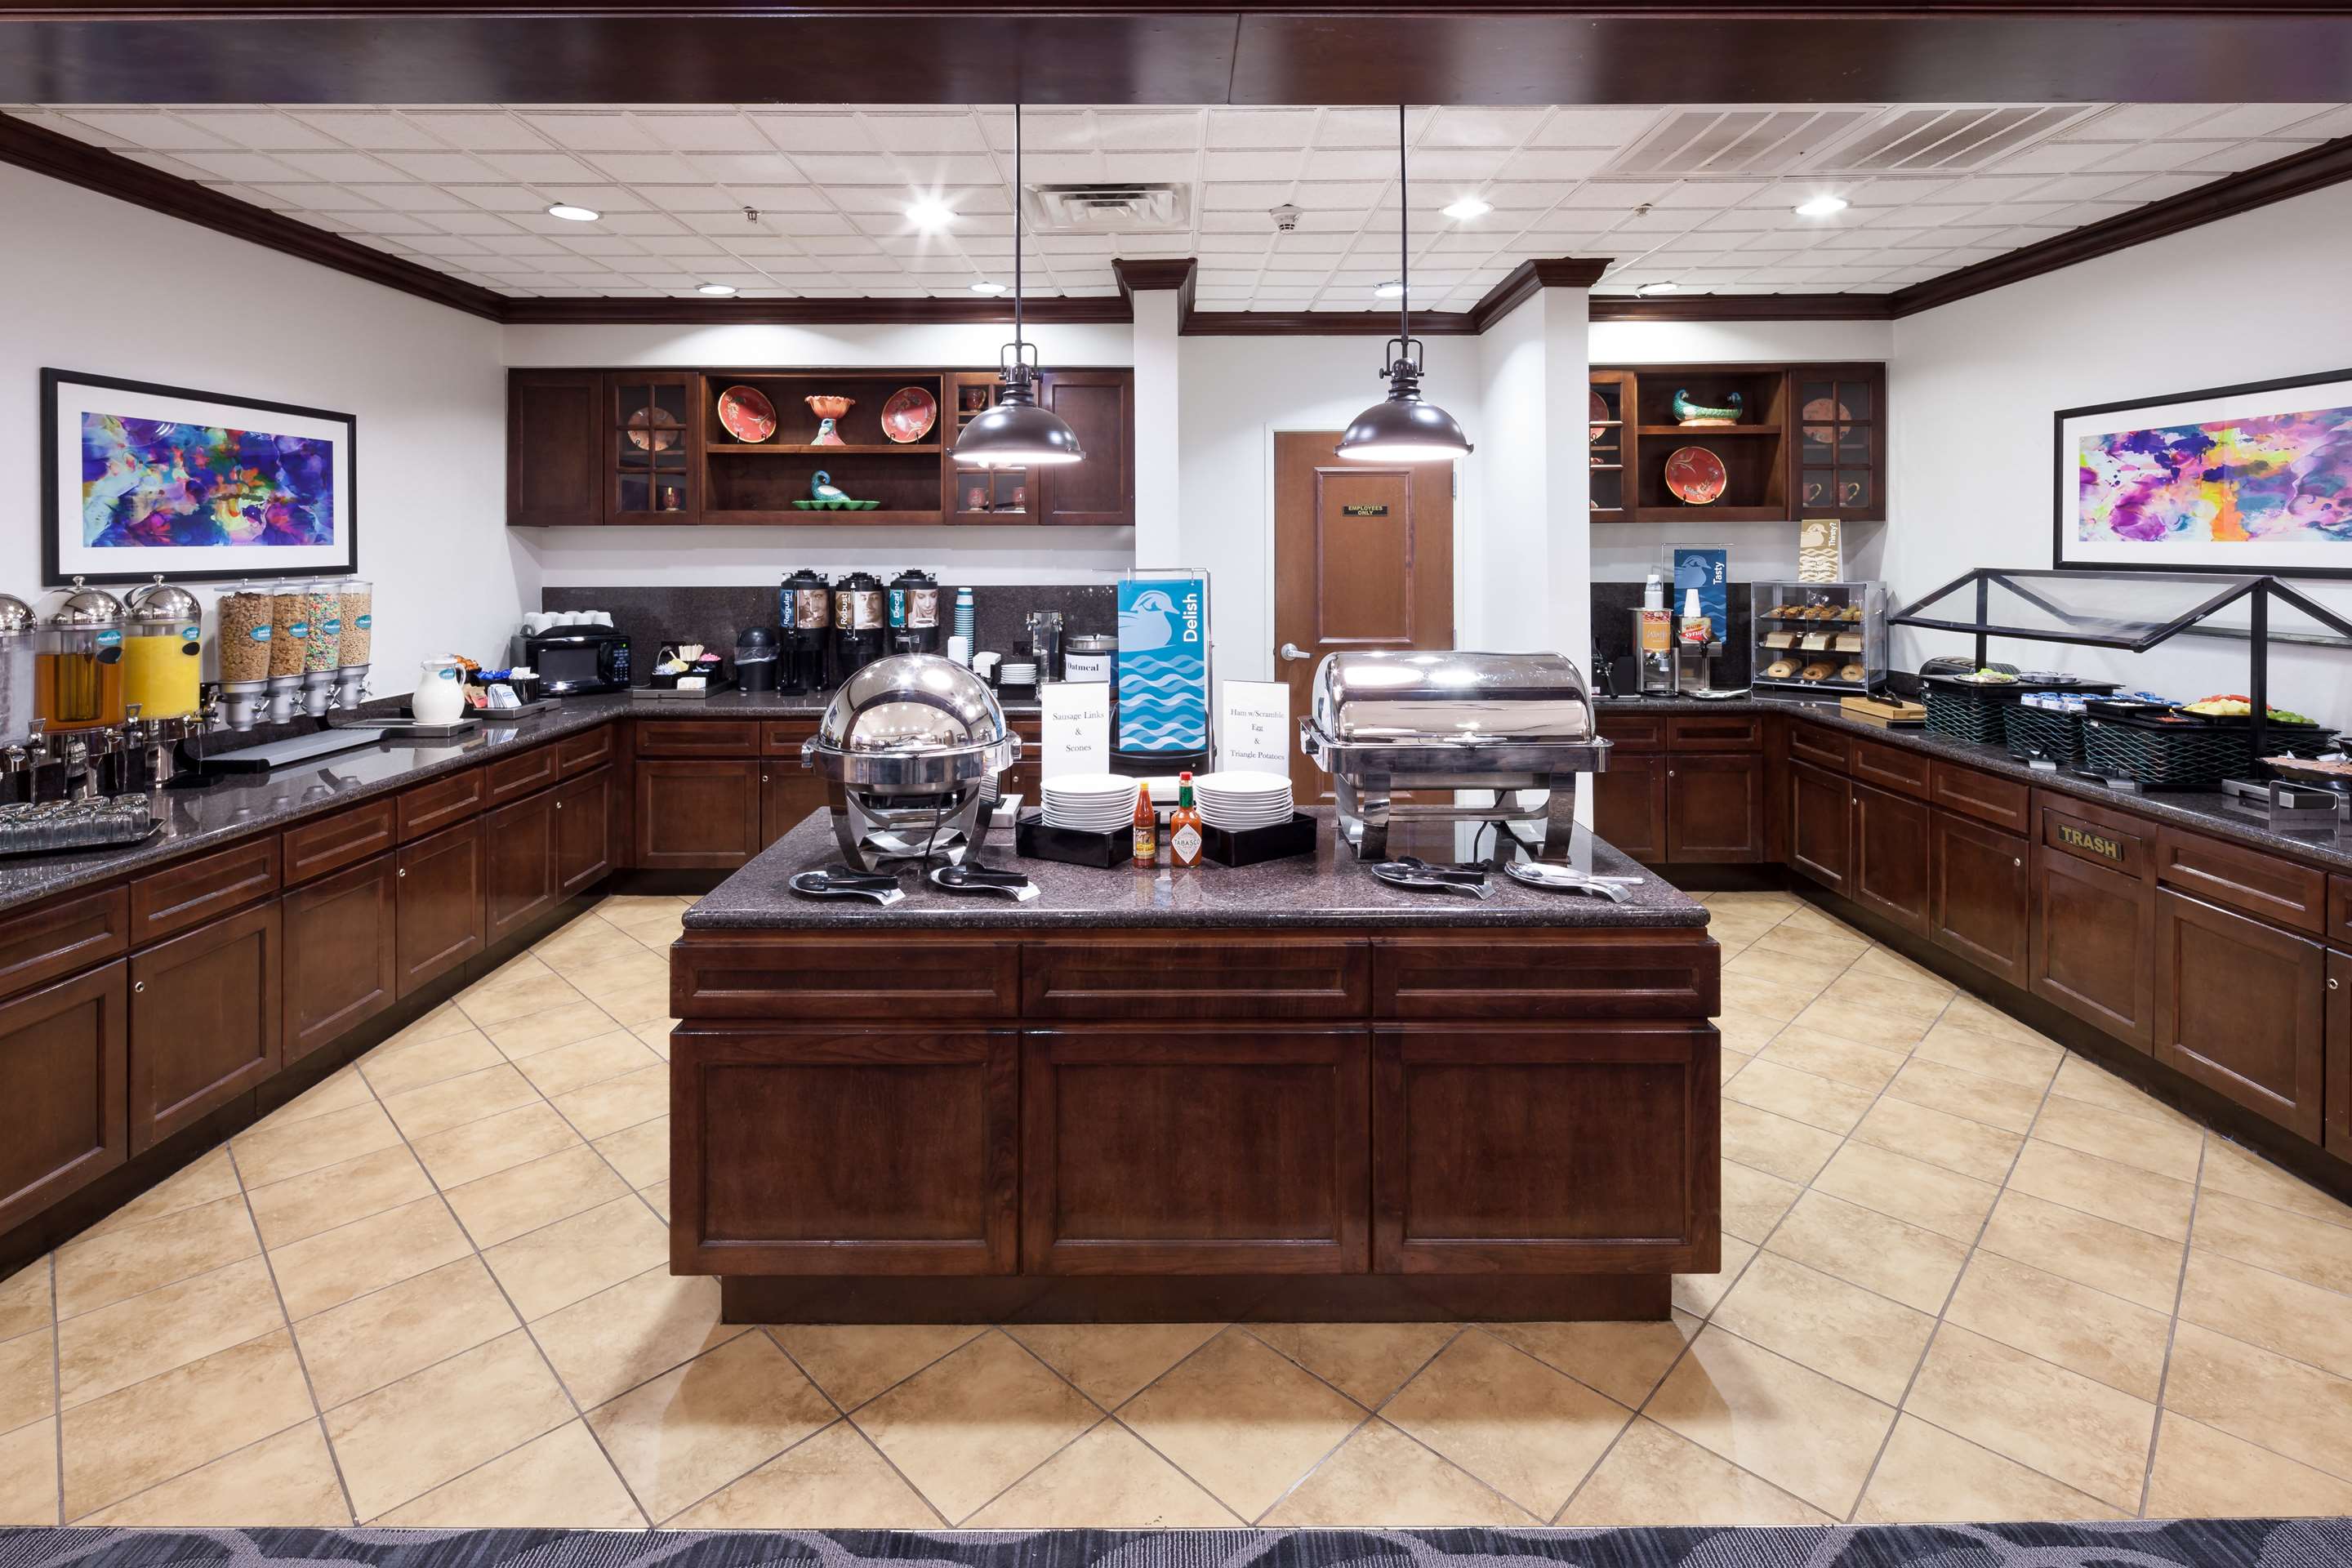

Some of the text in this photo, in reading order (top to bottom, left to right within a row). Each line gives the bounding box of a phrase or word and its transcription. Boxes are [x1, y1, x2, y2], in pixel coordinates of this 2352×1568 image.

[1829, 522, 1838, 546] Thirsty?
[1713, 562, 1725, 585] Tasty
[1183, 593, 1197, 642] Delish
[1067, 662, 1099, 671] Oatmeal
[1084, 710, 1105, 719] Links
[1231, 708, 1247, 716] Ham
[1075, 728, 1082, 736] &
[1251, 724, 1263, 732] Egg
[1066, 744, 1092, 752] Scones
[1230, 750, 1285, 760] Triangle Potatoes
[2062, 826, 2117, 858] TRASH
